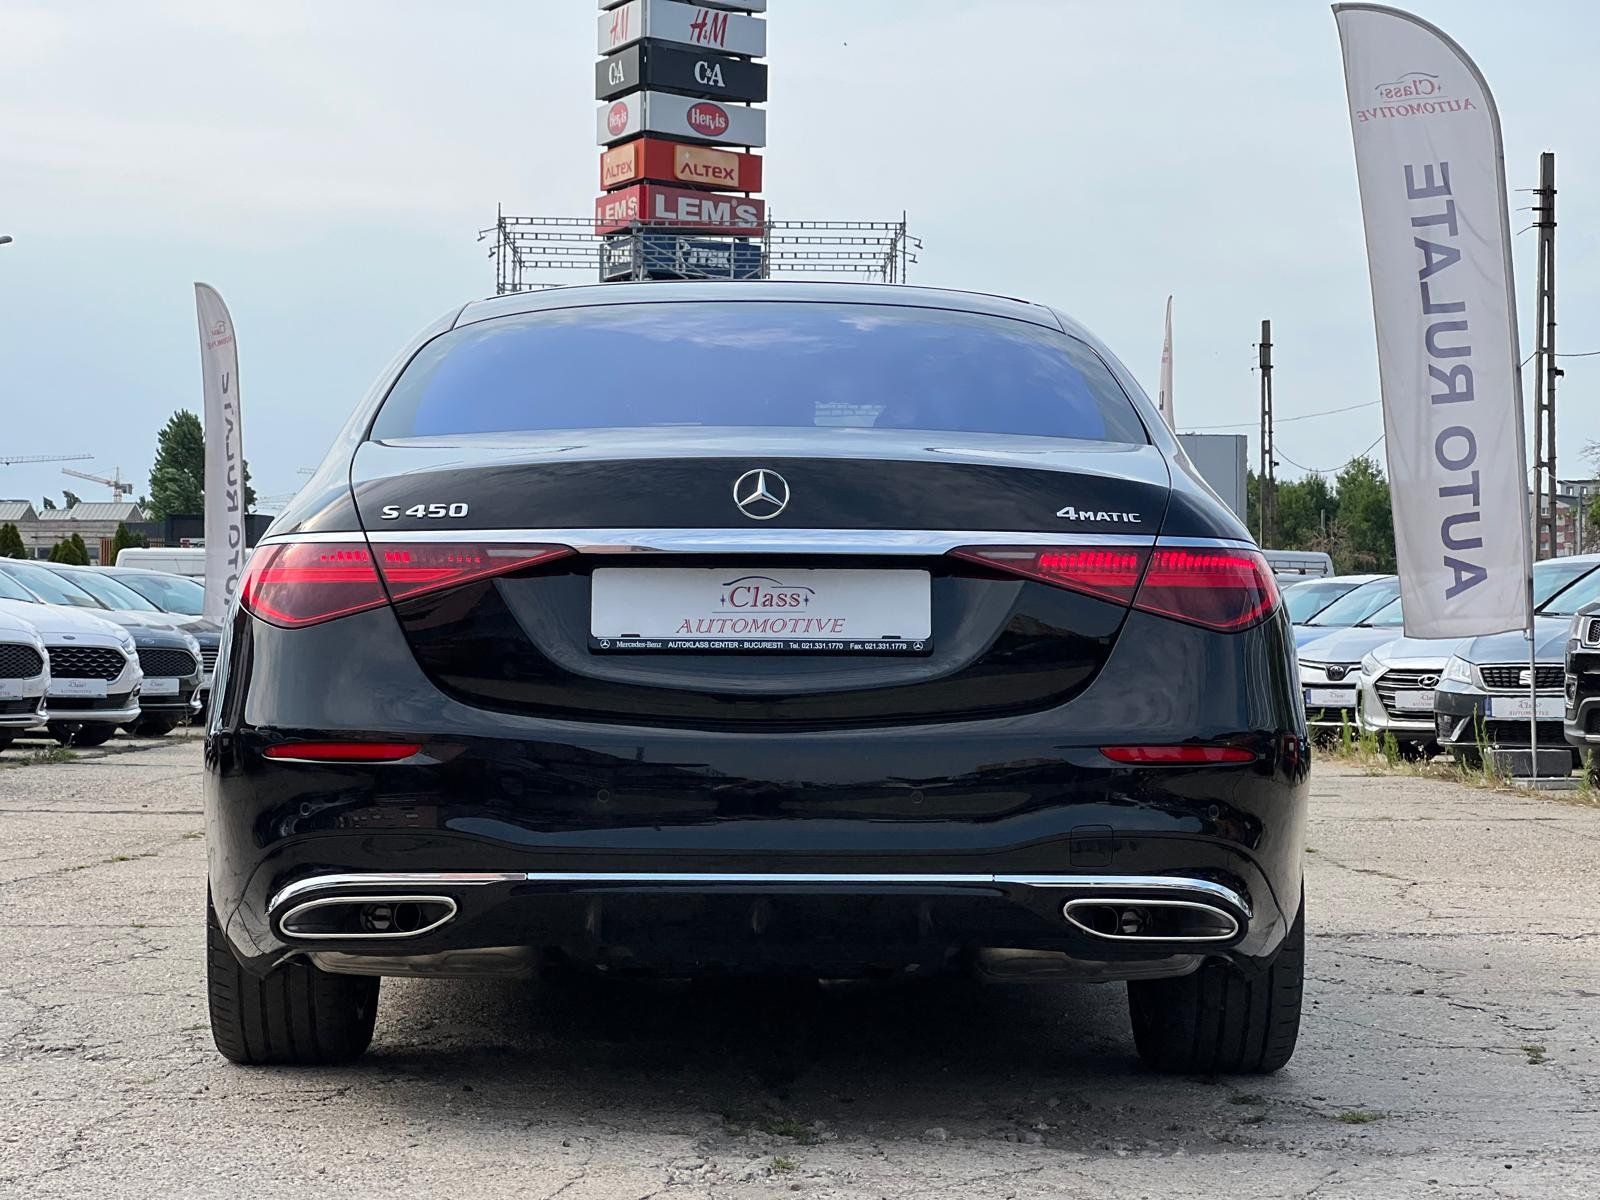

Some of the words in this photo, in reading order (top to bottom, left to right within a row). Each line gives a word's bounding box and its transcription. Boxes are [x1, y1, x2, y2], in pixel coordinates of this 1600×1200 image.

[690, 9, 728, 48] H&M
[694, 61, 725, 87] C&A
[691, 108, 726, 129] Hervis
[655, 193, 758, 228] LEM'S
[381, 505, 400, 519] S
[405, 503, 469, 518] 450
[1056, 506, 1142, 523] 4MATIC
[729, 586, 801, 608] Class
[676, 618, 846, 634] AUTOMOTIVE
[616, 641, 662, 649] Mercedes-Benz
[667, 641, 708, 649] AUTOKLASS
[710, 641, 739, 649] CENTER
[743, 641, 783, 649] BUCURESTI
[850, 642, 863, 650] Fax.
